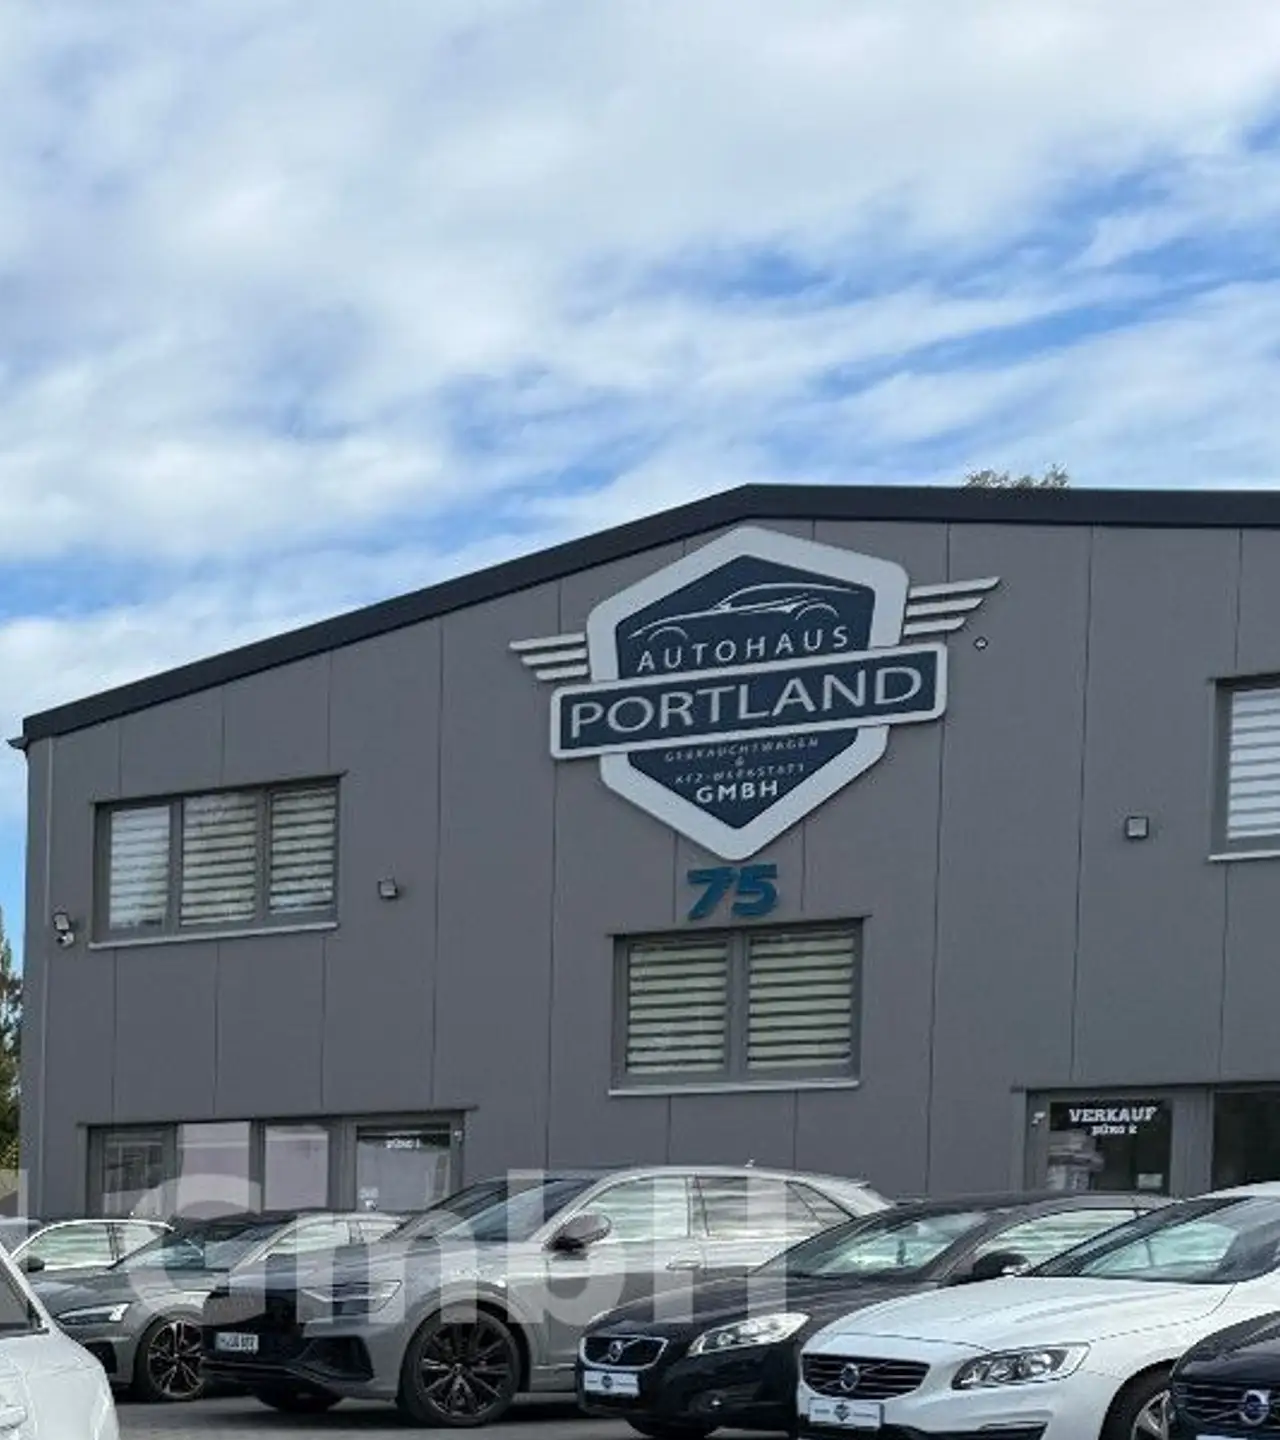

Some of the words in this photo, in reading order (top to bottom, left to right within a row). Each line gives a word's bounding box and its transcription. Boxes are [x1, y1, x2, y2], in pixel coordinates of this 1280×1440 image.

[637, 625, 849, 673] AUTOHAUS
[570, 665, 922, 739] PORTLAND
[696, 780, 778, 803] GMBH
[687, 864, 777, 921] 75
[1068, 1106, 1157, 1123] VERKAUF
